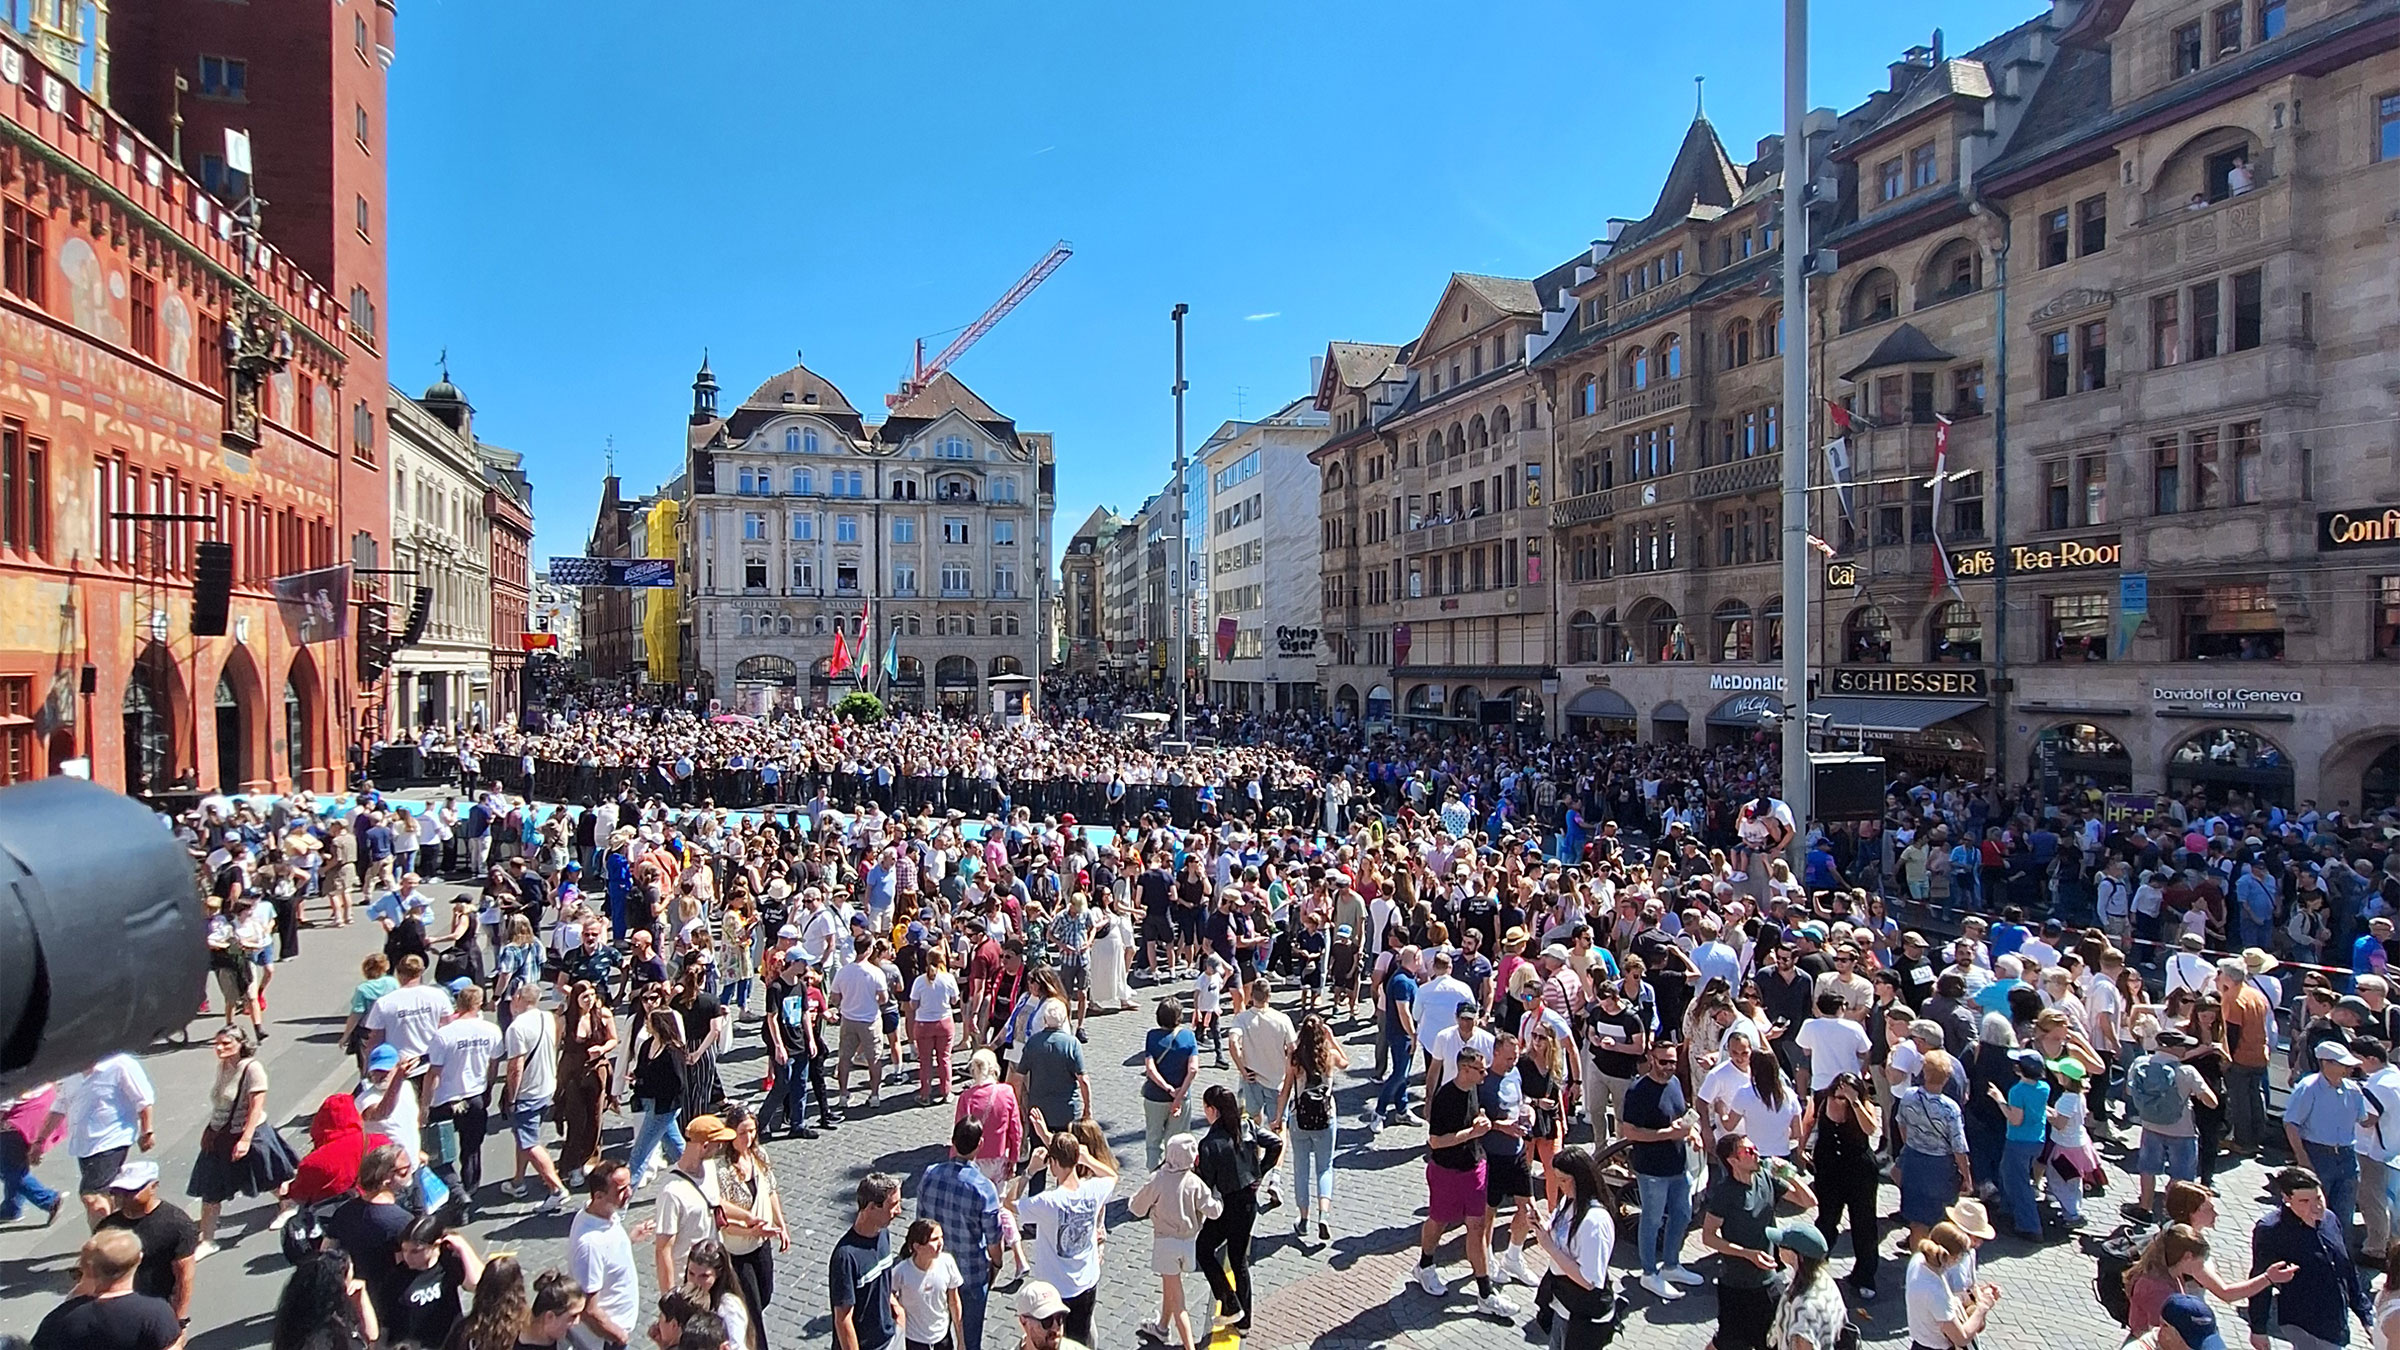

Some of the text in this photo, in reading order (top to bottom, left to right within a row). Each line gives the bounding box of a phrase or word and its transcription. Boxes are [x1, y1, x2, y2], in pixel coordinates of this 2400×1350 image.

[1951, 550, 1995, 576] Café
[1276, 625, 1318, 641] flying
[1279, 639, 1316, 652] tiger
[1840, 672, 1977, 693] SCHIESSER
[2153, 687, 2302, 702] Davidoff of Geneva
[2202, 701, 2246, 710] since 1911
[2108, 807, 2155, 823] HEP
